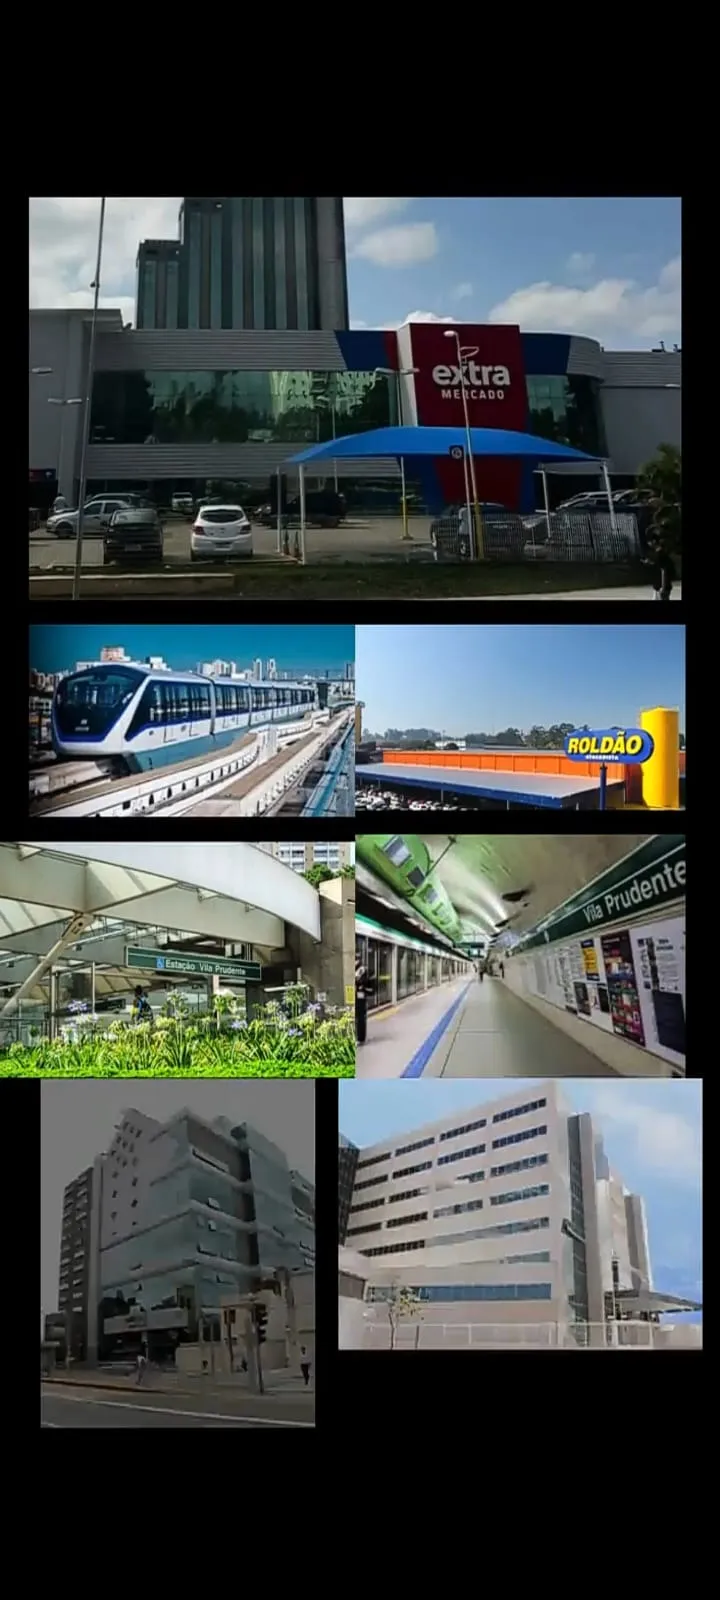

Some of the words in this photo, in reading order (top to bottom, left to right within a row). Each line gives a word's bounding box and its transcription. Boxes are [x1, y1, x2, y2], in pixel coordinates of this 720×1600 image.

[432, 360, 511, 386] extra
[568, 731, 642, 755] ROLDÃO
[583, 904, 604, 923] Vila
[604, 861, 686, 915] Prudente
[165, 959, 196, 971] Estação
[200, 963, 213, 973] Vila
[215, 965, 246, 976] Prudente
